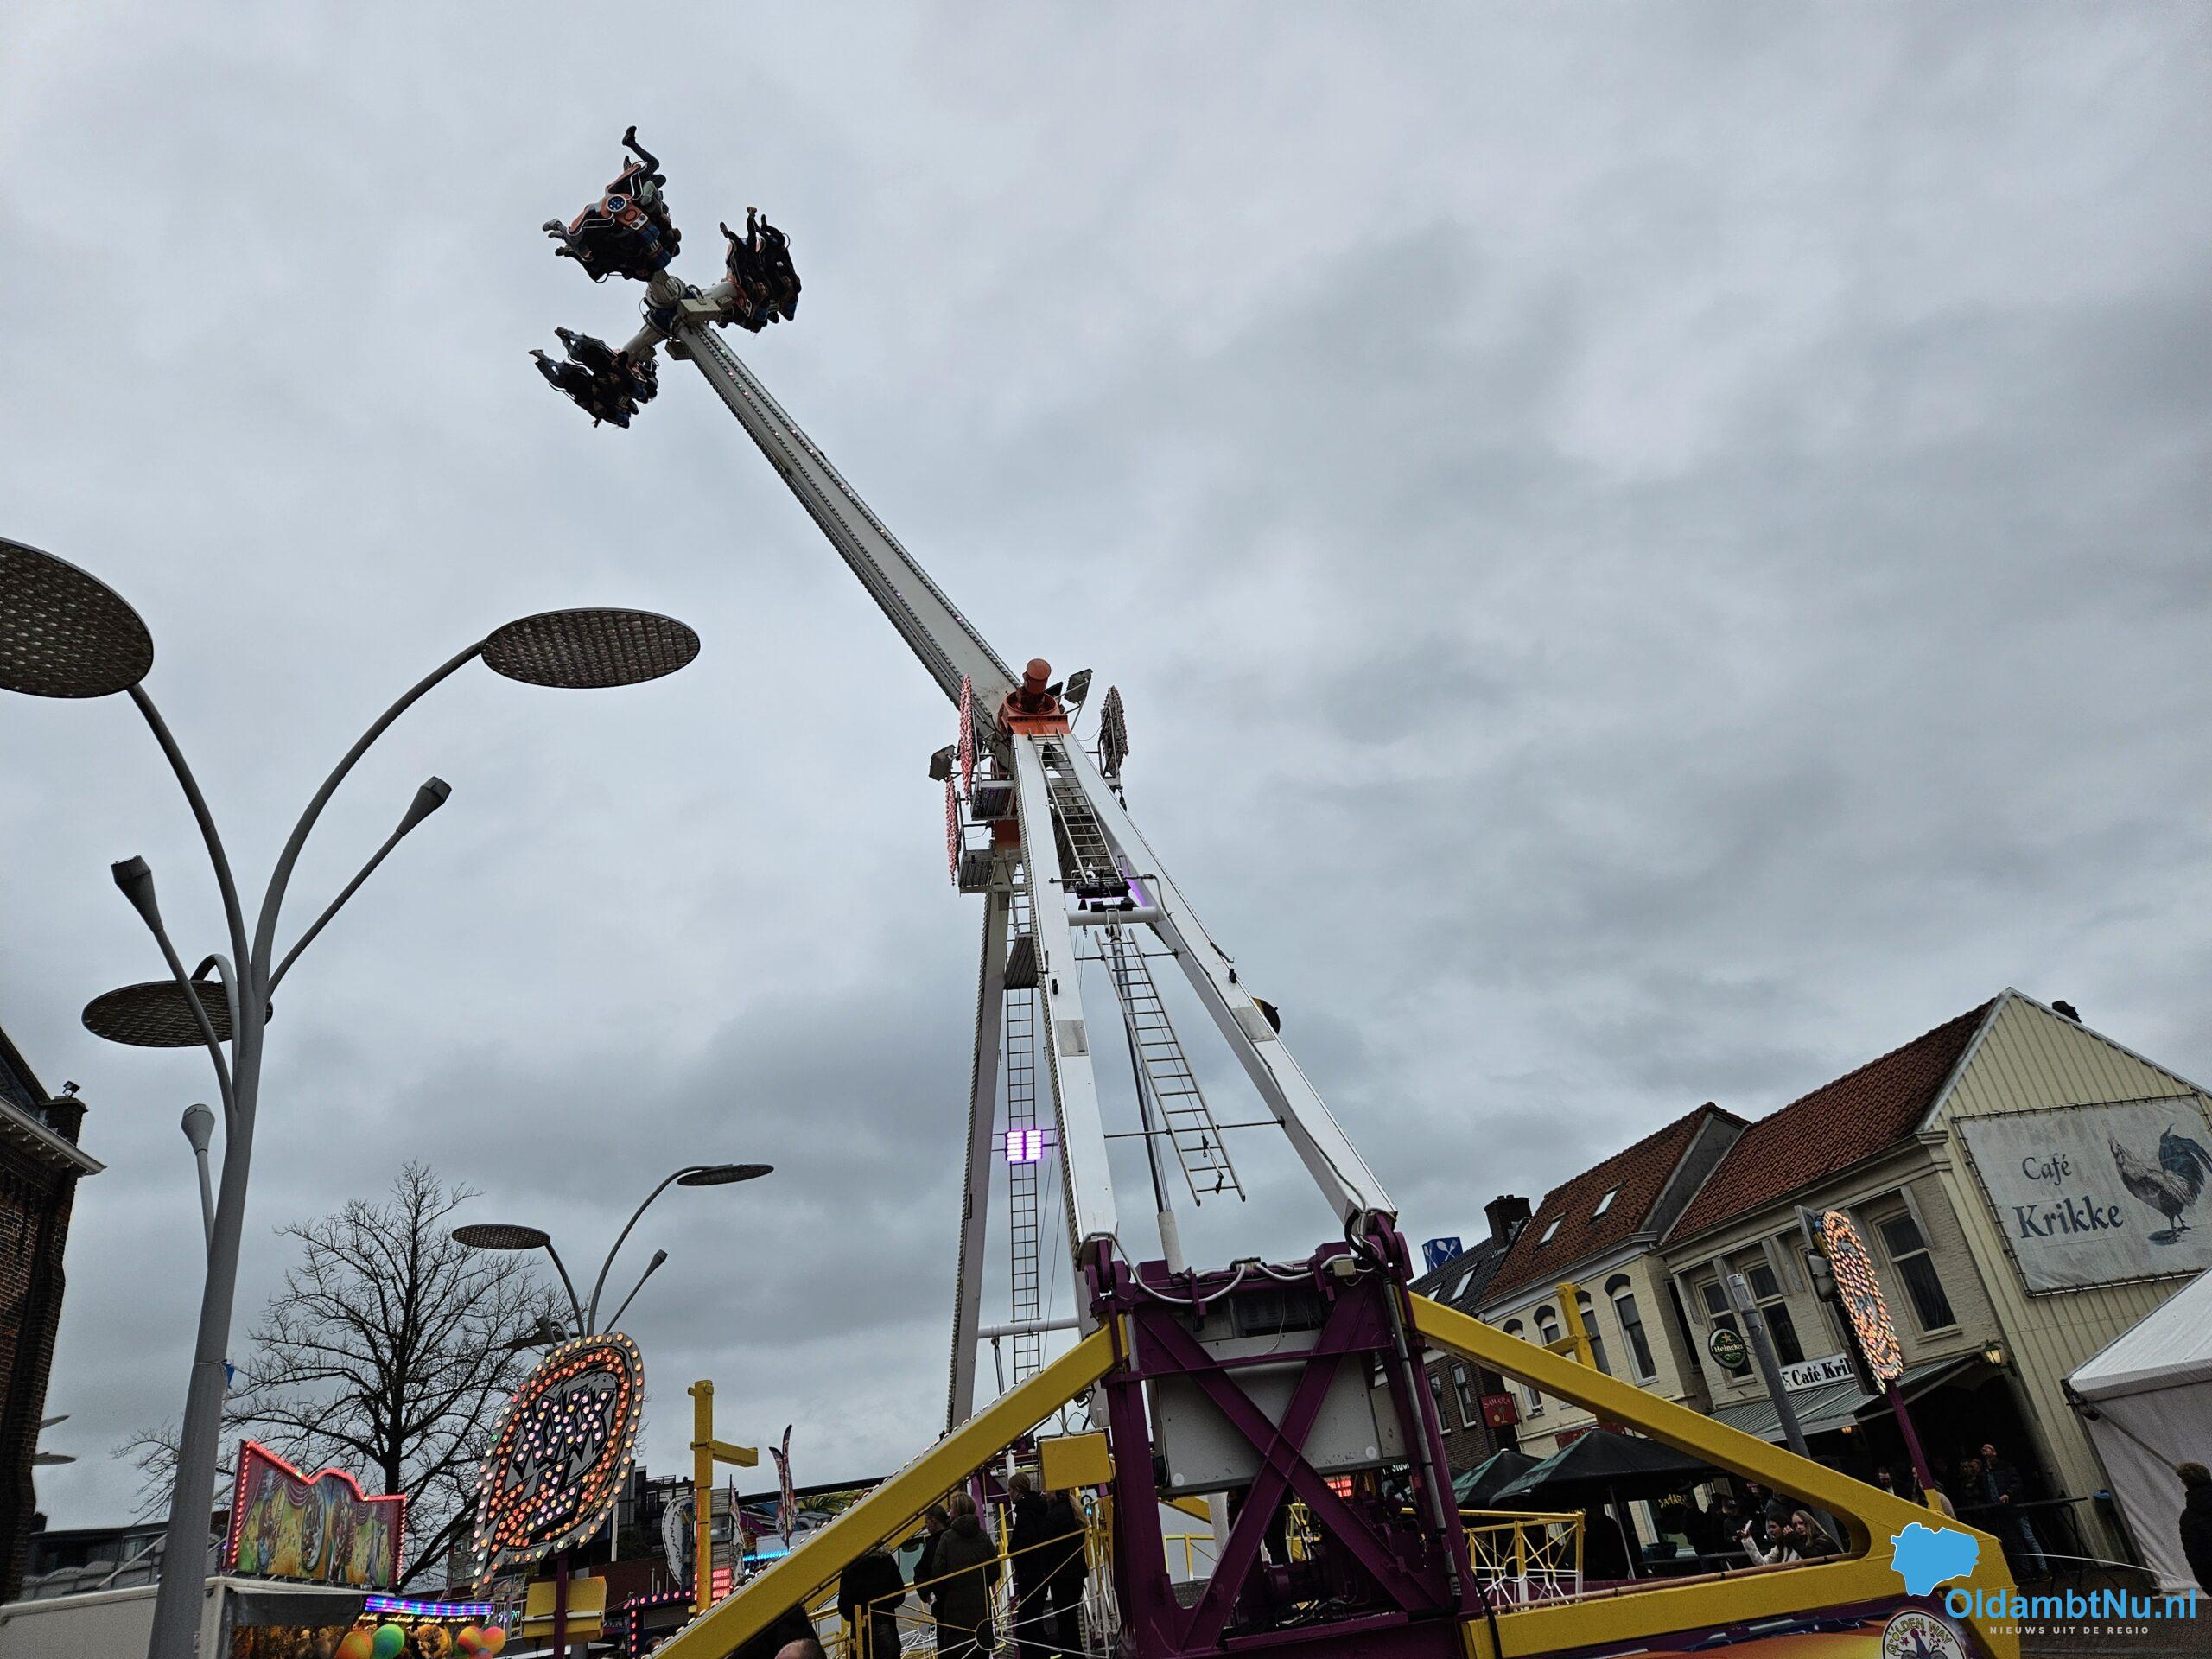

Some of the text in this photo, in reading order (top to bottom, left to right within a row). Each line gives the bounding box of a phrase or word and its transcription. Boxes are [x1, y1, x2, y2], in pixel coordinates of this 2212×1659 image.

[2022, 1153, 2072, 1185] Café
[2012, 1196, 2124, 1239] Krikke
[1791, 1366, 1821, 1386] Café
[1658, 1493, 1687, 1510] SAHAR
[1928, 1621, 1953, 1644] WAY
